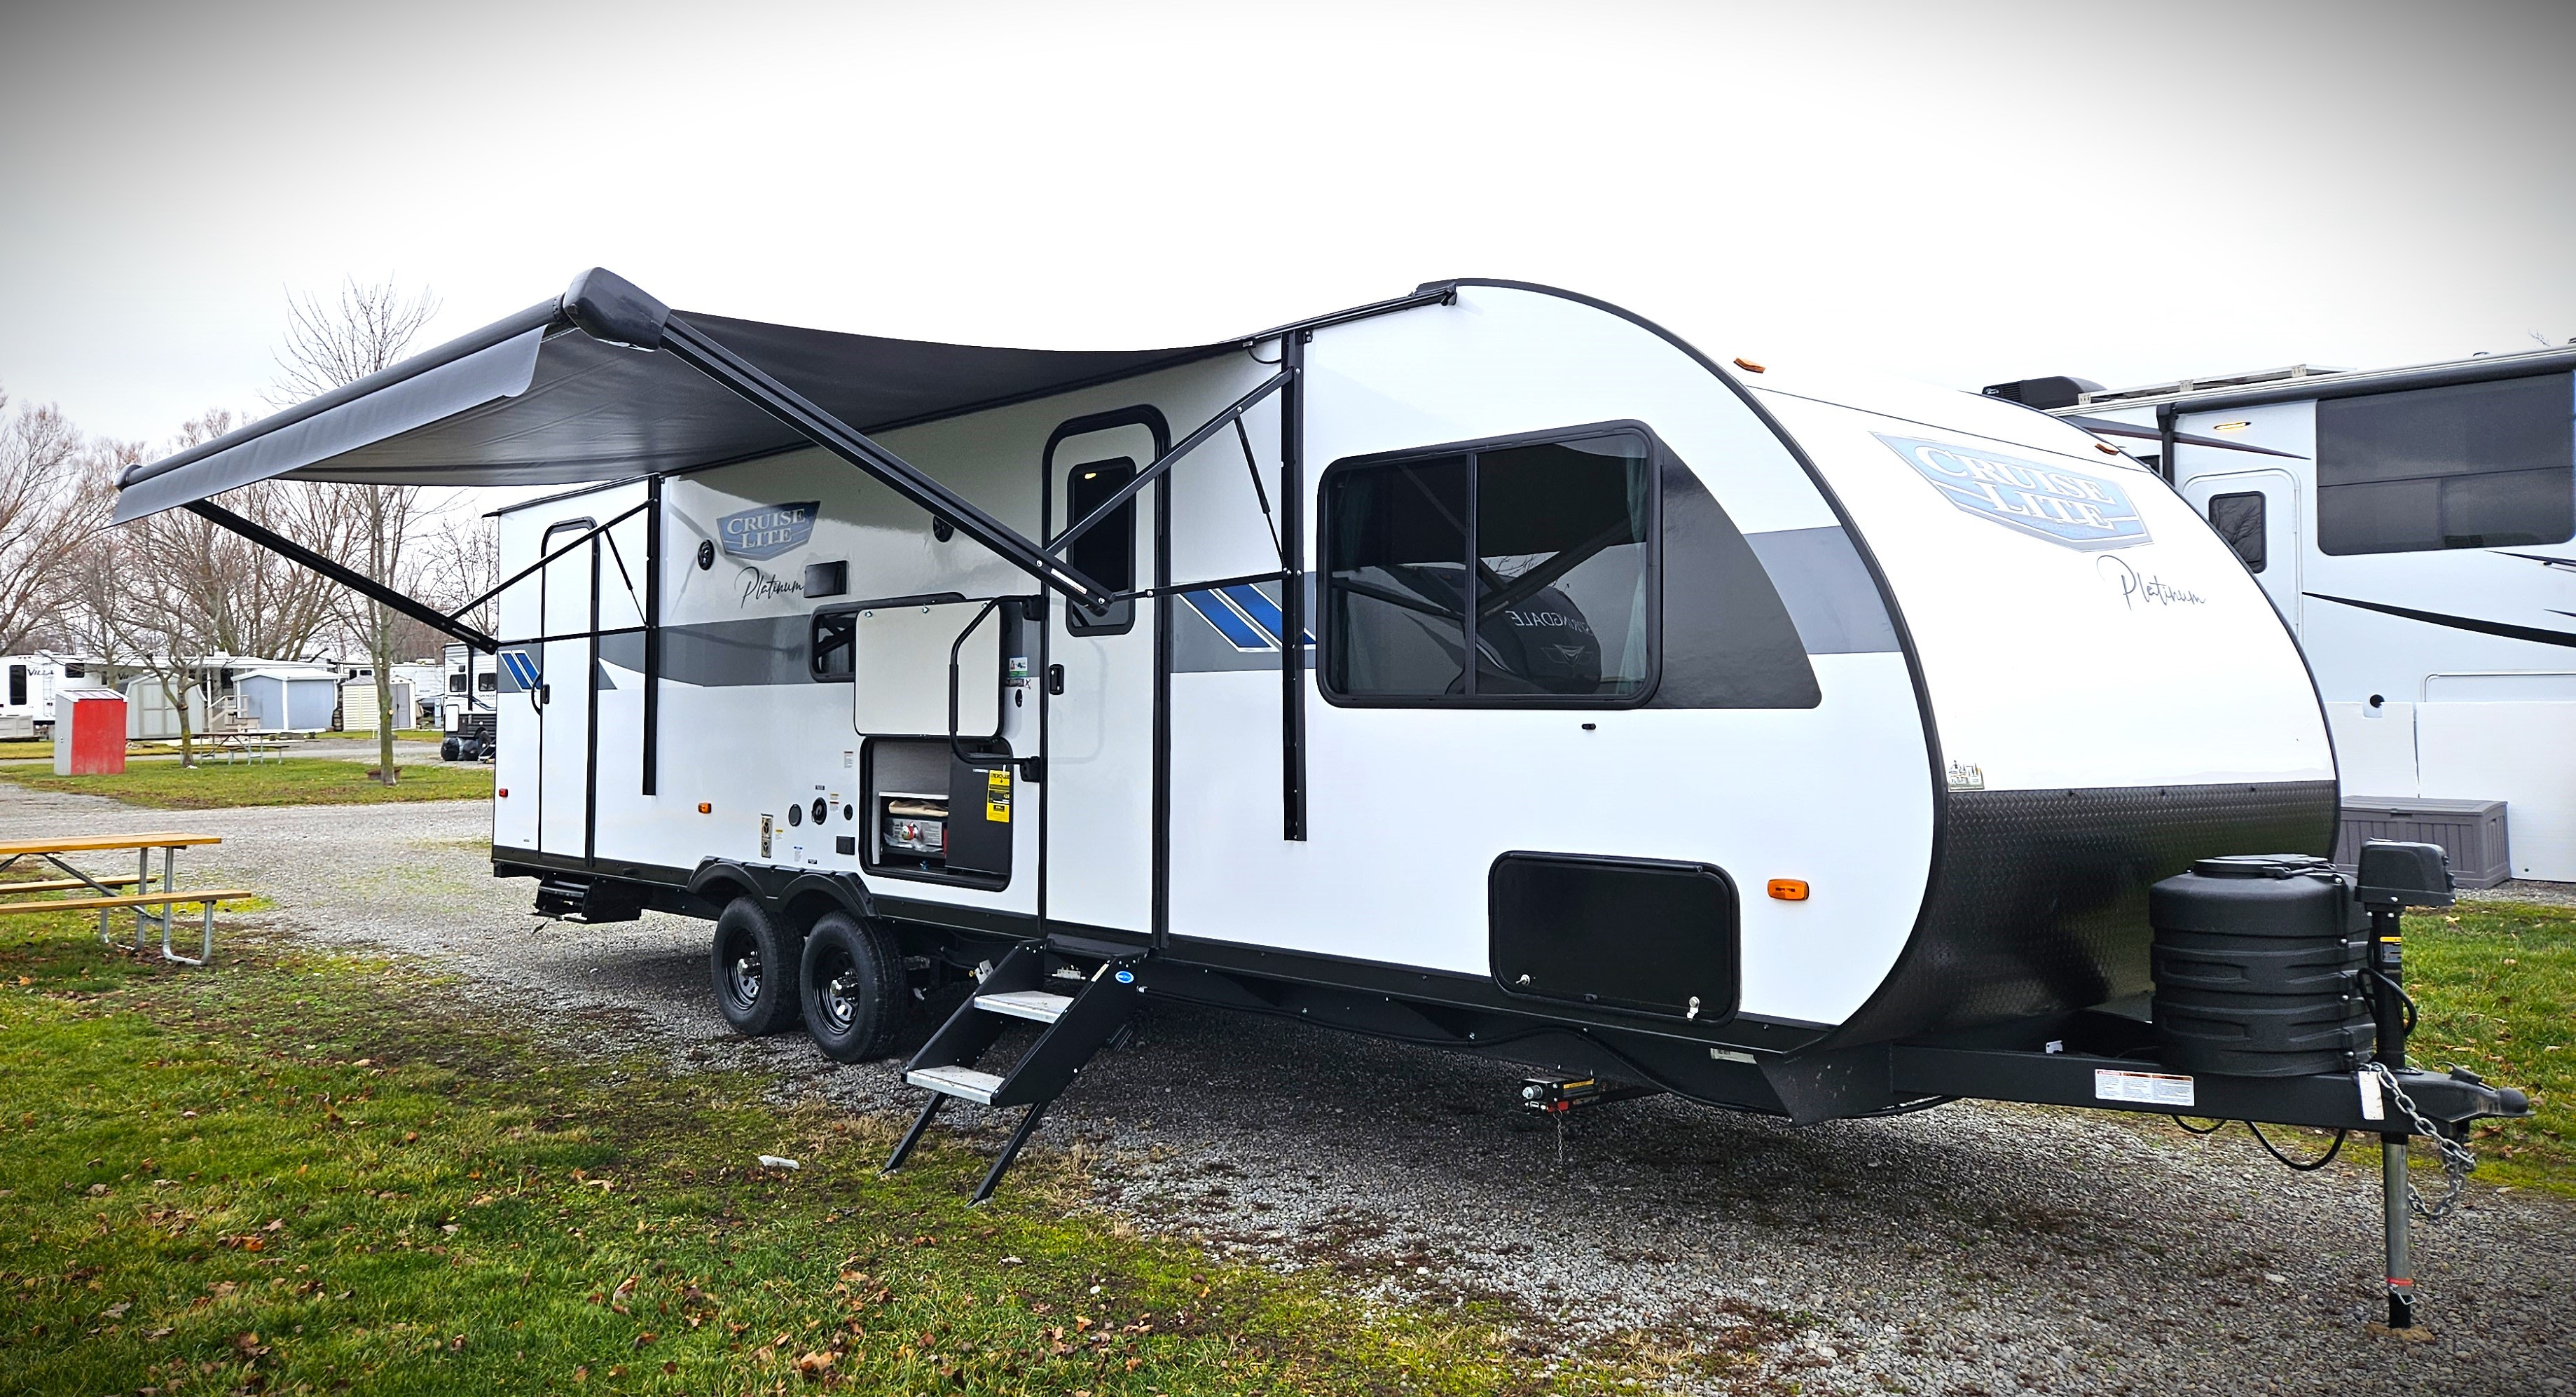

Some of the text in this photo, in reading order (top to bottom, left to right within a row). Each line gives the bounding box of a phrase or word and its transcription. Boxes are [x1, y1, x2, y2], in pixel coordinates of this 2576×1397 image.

[1914, 446, 2117, 505] CRUISE
[726, 509, 806, 535] CRUISE
[1971, 479, 2115, 530] LITE
[741, 527, 792, 549] LITE
[733, 565, 805, 609] Platinum
[2096, 554, 2206, 611] Platinum
[27, 668, 55, 677] VILLA
